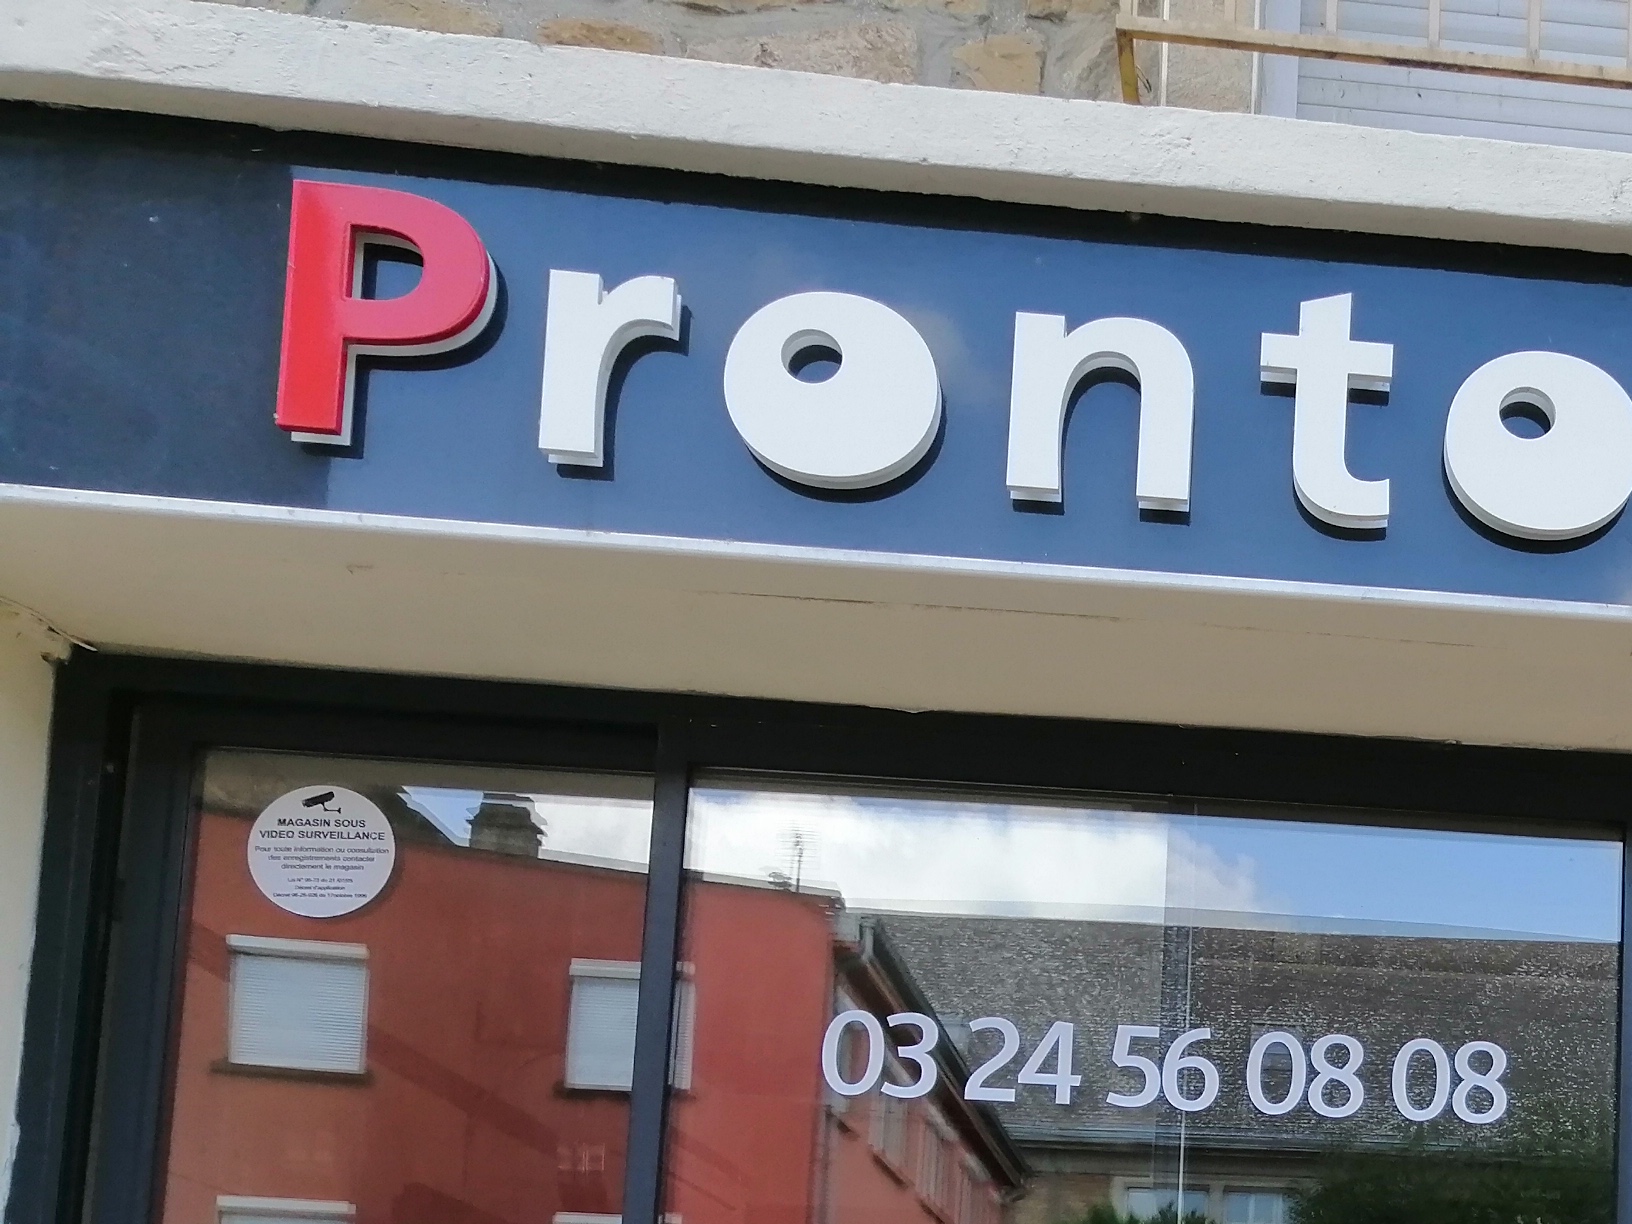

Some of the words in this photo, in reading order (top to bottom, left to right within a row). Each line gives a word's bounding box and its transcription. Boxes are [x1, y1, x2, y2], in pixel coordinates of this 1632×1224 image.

[277, 818, 331, 828] MAGASIN
[334, 819, 366, 828] SOUS
[259, 830, 295, 839] VIDEO
[298, 830, 385, 841] SURVEILLANCE
[294, 846, 334, 854] information
[821, 1009, 939, 1099] 03
[963, 1016, 1082, 1106] 24
[1105, 1024, 1219, 1112] 56
[1246, 1031, 1365, 1119] 08
[1391, 1038, 1508, 1125] 08
